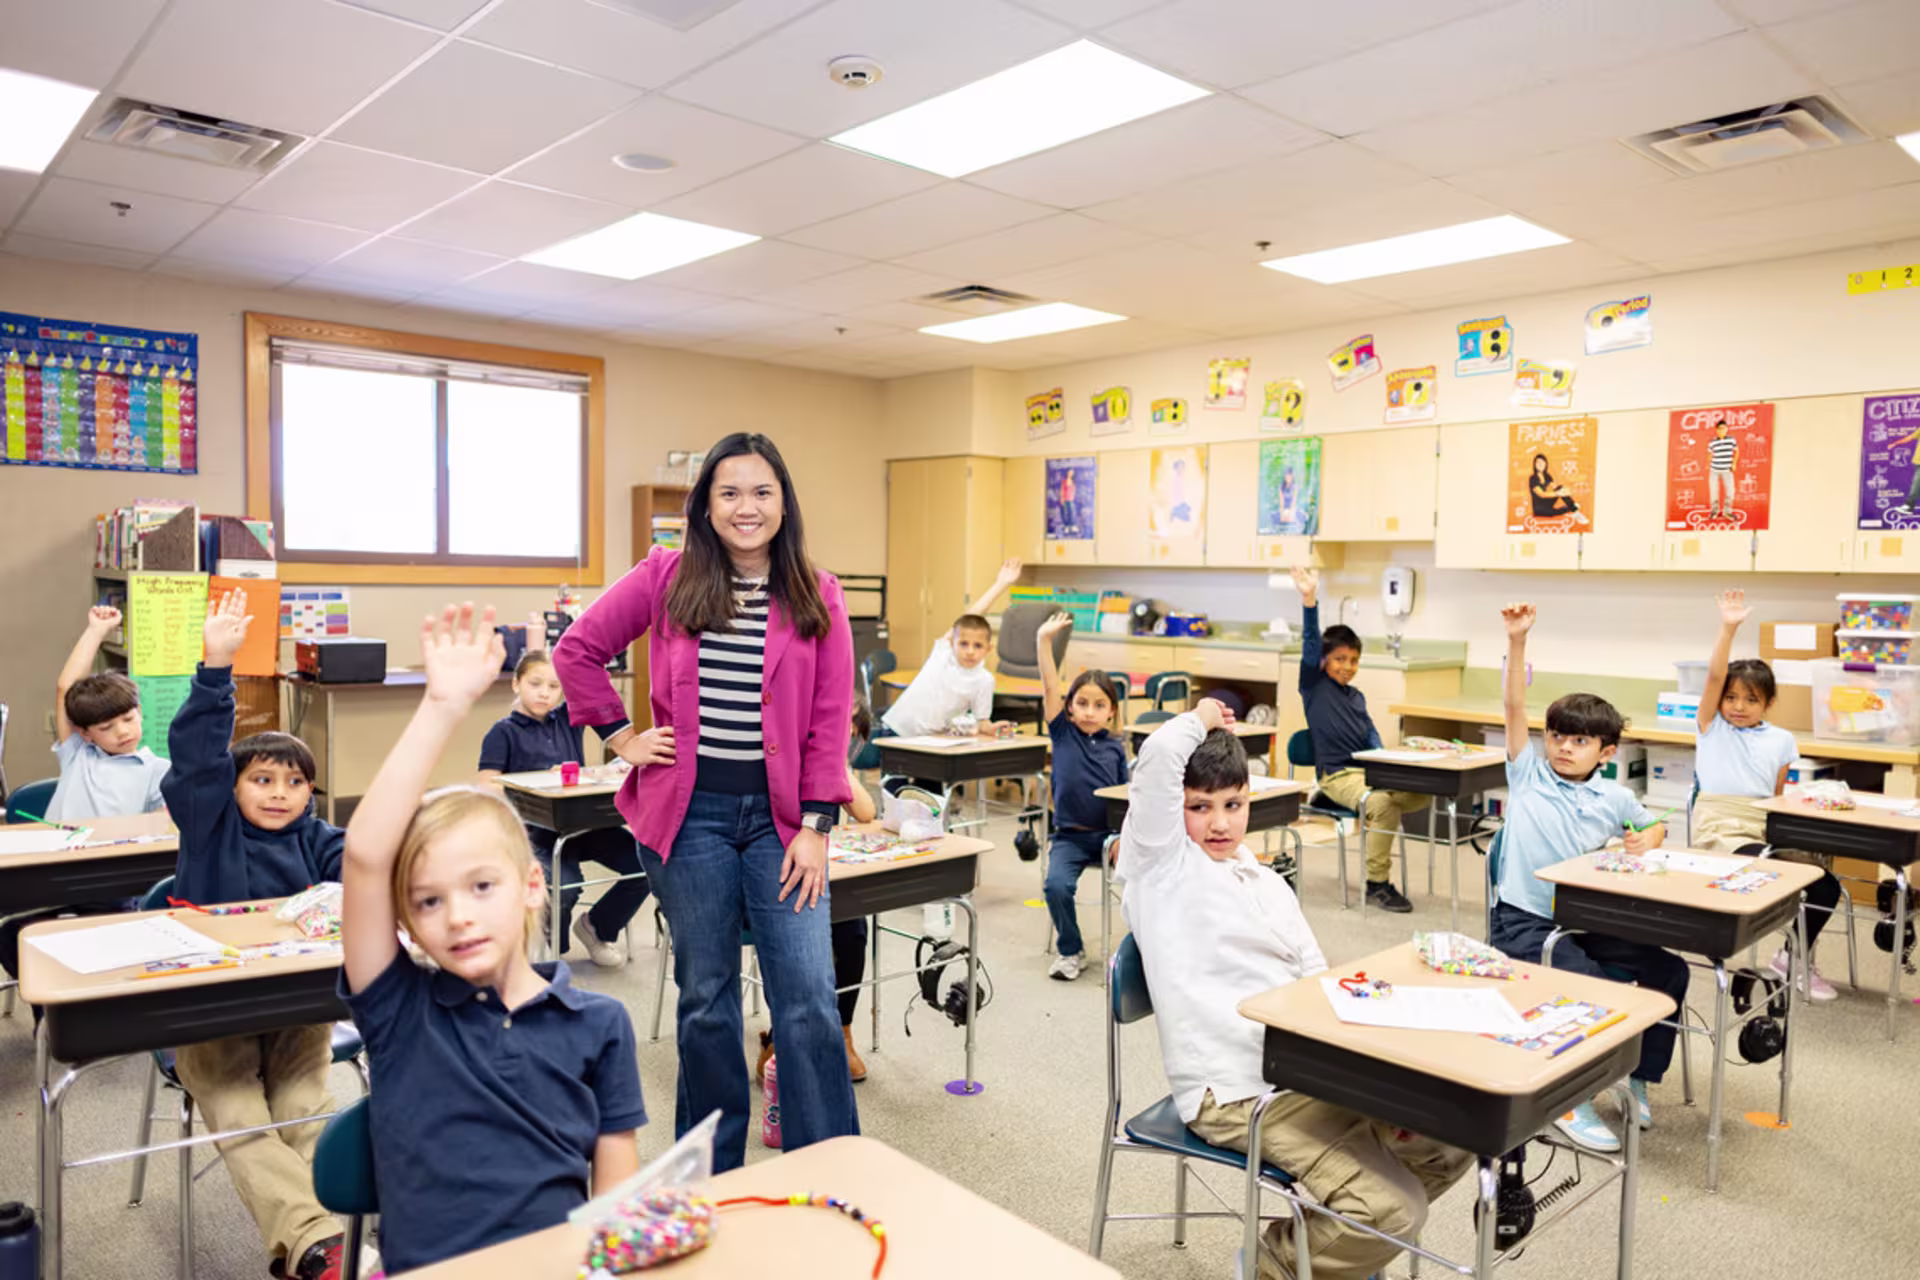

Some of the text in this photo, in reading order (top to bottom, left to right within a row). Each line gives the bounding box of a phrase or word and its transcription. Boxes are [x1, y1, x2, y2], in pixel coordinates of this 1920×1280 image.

[1904, 267, 1913, 279] 2
[1681, 408, 1757, 430] CARING
[1517, 421, 1585, 442] FAIRNESS
